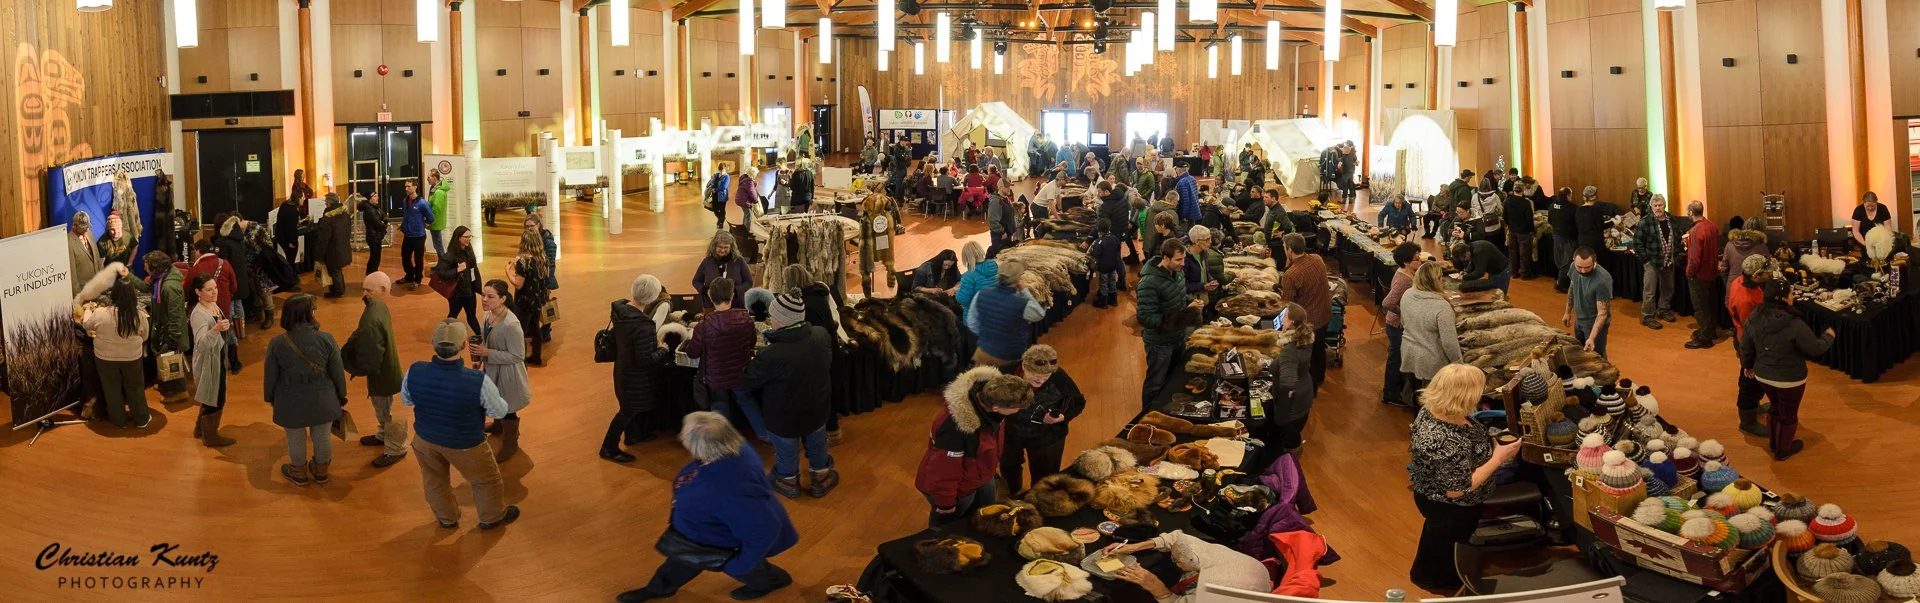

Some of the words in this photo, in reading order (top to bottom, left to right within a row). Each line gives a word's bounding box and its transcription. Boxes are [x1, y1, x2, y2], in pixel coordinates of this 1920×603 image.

[73, 169, 87, 184] YUKON
[87, 163, 116, 180] TRAPPERS
[117, 158, 162, 174] ASSOCIATION
[3, 285, 22, 299] FUR
[23, 270, 68, 292] INDUSTRY
[15, 263, 55, 283] YUKON'S
